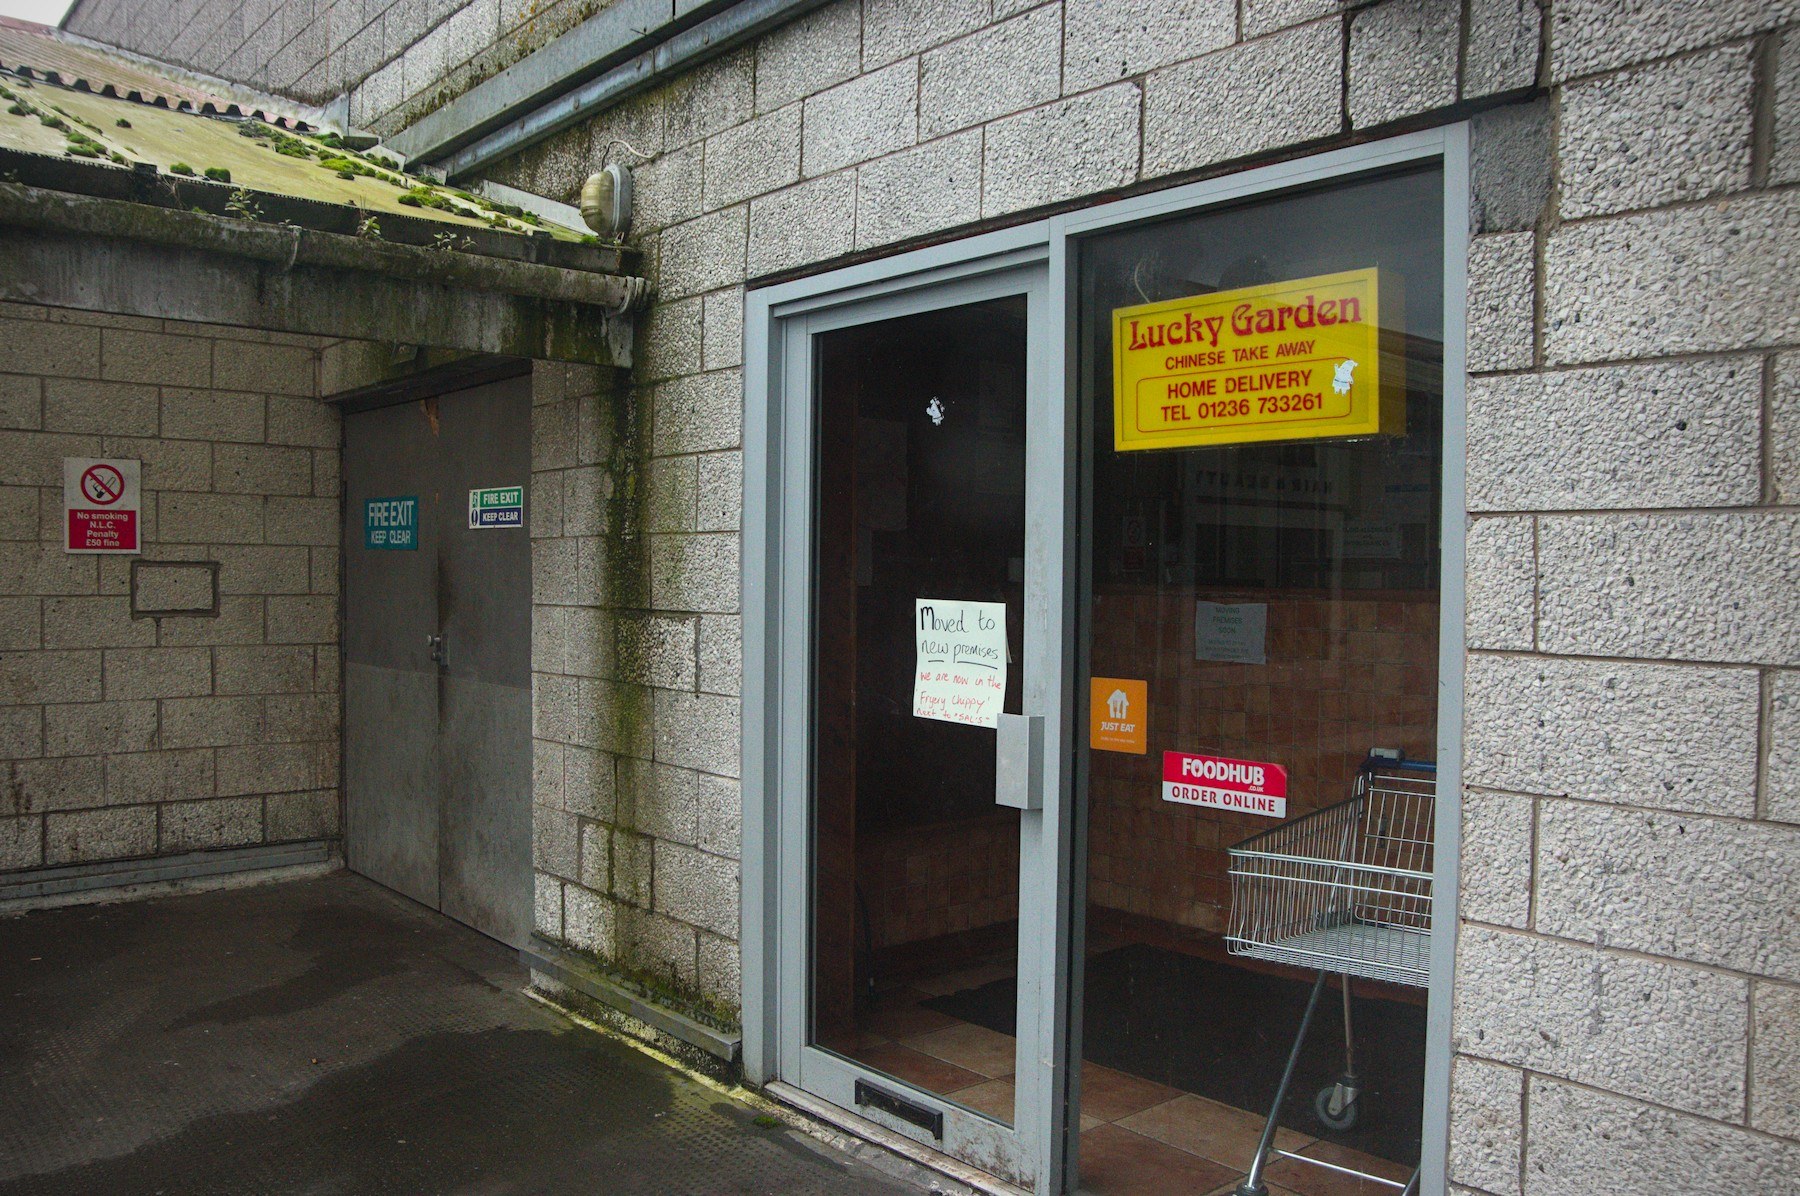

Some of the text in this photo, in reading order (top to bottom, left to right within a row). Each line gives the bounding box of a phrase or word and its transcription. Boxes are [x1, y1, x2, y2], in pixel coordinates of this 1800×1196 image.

[1128, 295, 1362, 352] Lucky Garden
[1165, 340, 1316, 370] CHINESE TAKE AWAY
[1167, 369, 1313, 399] HOME DELIVERY
[1161, 393, 1323, 422] TEL 01236 733261
[483, 491, 519, 505] FIRE EXIT
[92, 513, 128, 521] smoking
[368, 500, 414, 527] FIRE EXIT
[482, 511, 519, 522] KEEP CLEAR
[87, 530, 119, 539] Penalty
[370, 530, 411, 544] KEEP CLEAR
[920, 606, 996, 633] Moved to
[921, 640, 999, 663] new premises
[935, 672, 949, 682] are
[975, 674, 984, 686] in
[987, 675, 1002, 690] the
[1100, 721, 1136, 733] JUST EAT
[1182, 757, 1265, 786] FOODHUB
[1172, 785, 1276, 813] ORDER ONLINE
